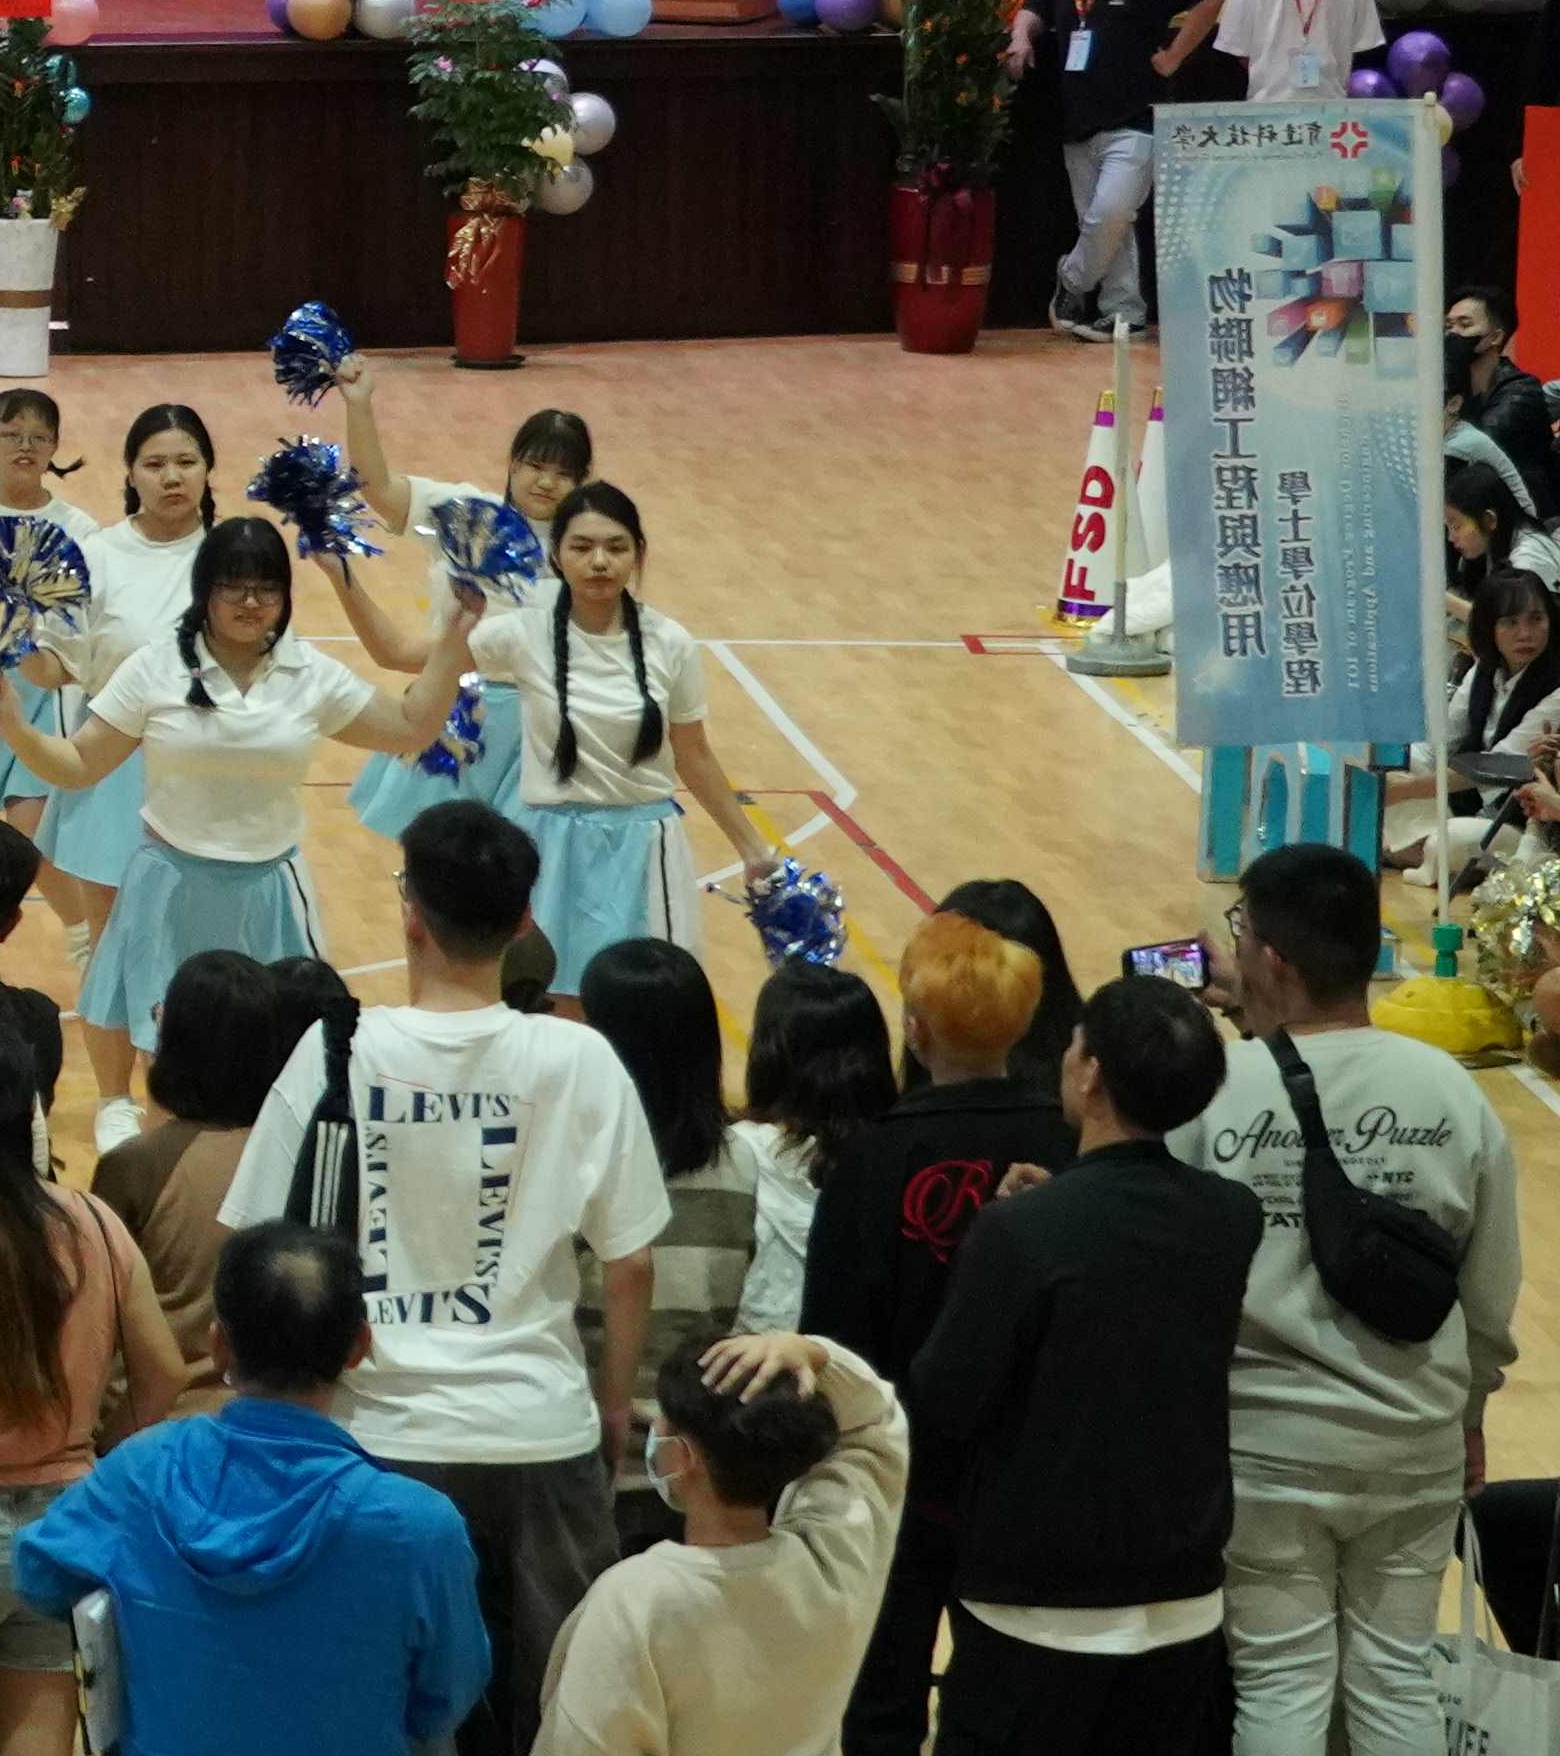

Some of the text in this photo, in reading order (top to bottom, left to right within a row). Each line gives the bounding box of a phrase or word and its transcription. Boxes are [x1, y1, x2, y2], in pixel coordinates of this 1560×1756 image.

[1063, 465, 1115, 602] FSD
[365, 1085, 511, 1124] LEVI'S
[1213, 1105, 1453, 1163] Anoer Puzzle
[475, 1126, 518, 1282] LEVI'S
